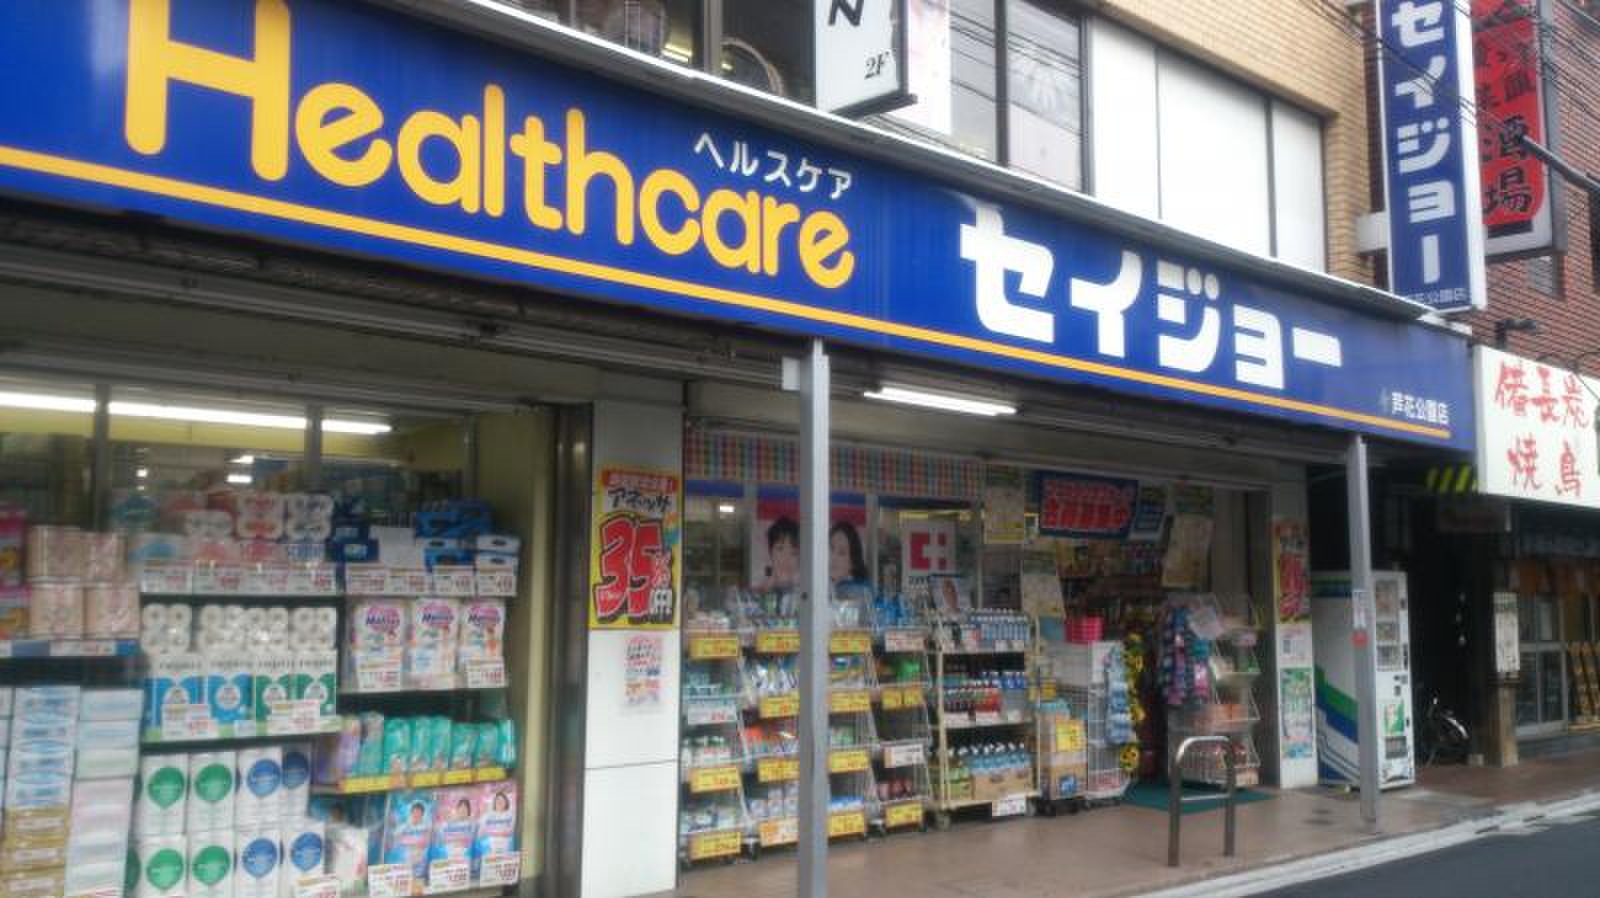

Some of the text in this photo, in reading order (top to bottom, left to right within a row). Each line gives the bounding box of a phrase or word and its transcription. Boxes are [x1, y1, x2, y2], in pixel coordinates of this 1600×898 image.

[863, 49, 890, 80] 2F
[124, 0, 854, 290] Healthcare
[693, 131, 854, 200] ヘルスケア
[1391, 0, 1456, 285] セイジョー
[958, 203, 1344, 391] セイジョー
[1494, 359, 1591, 430] 備長炭
